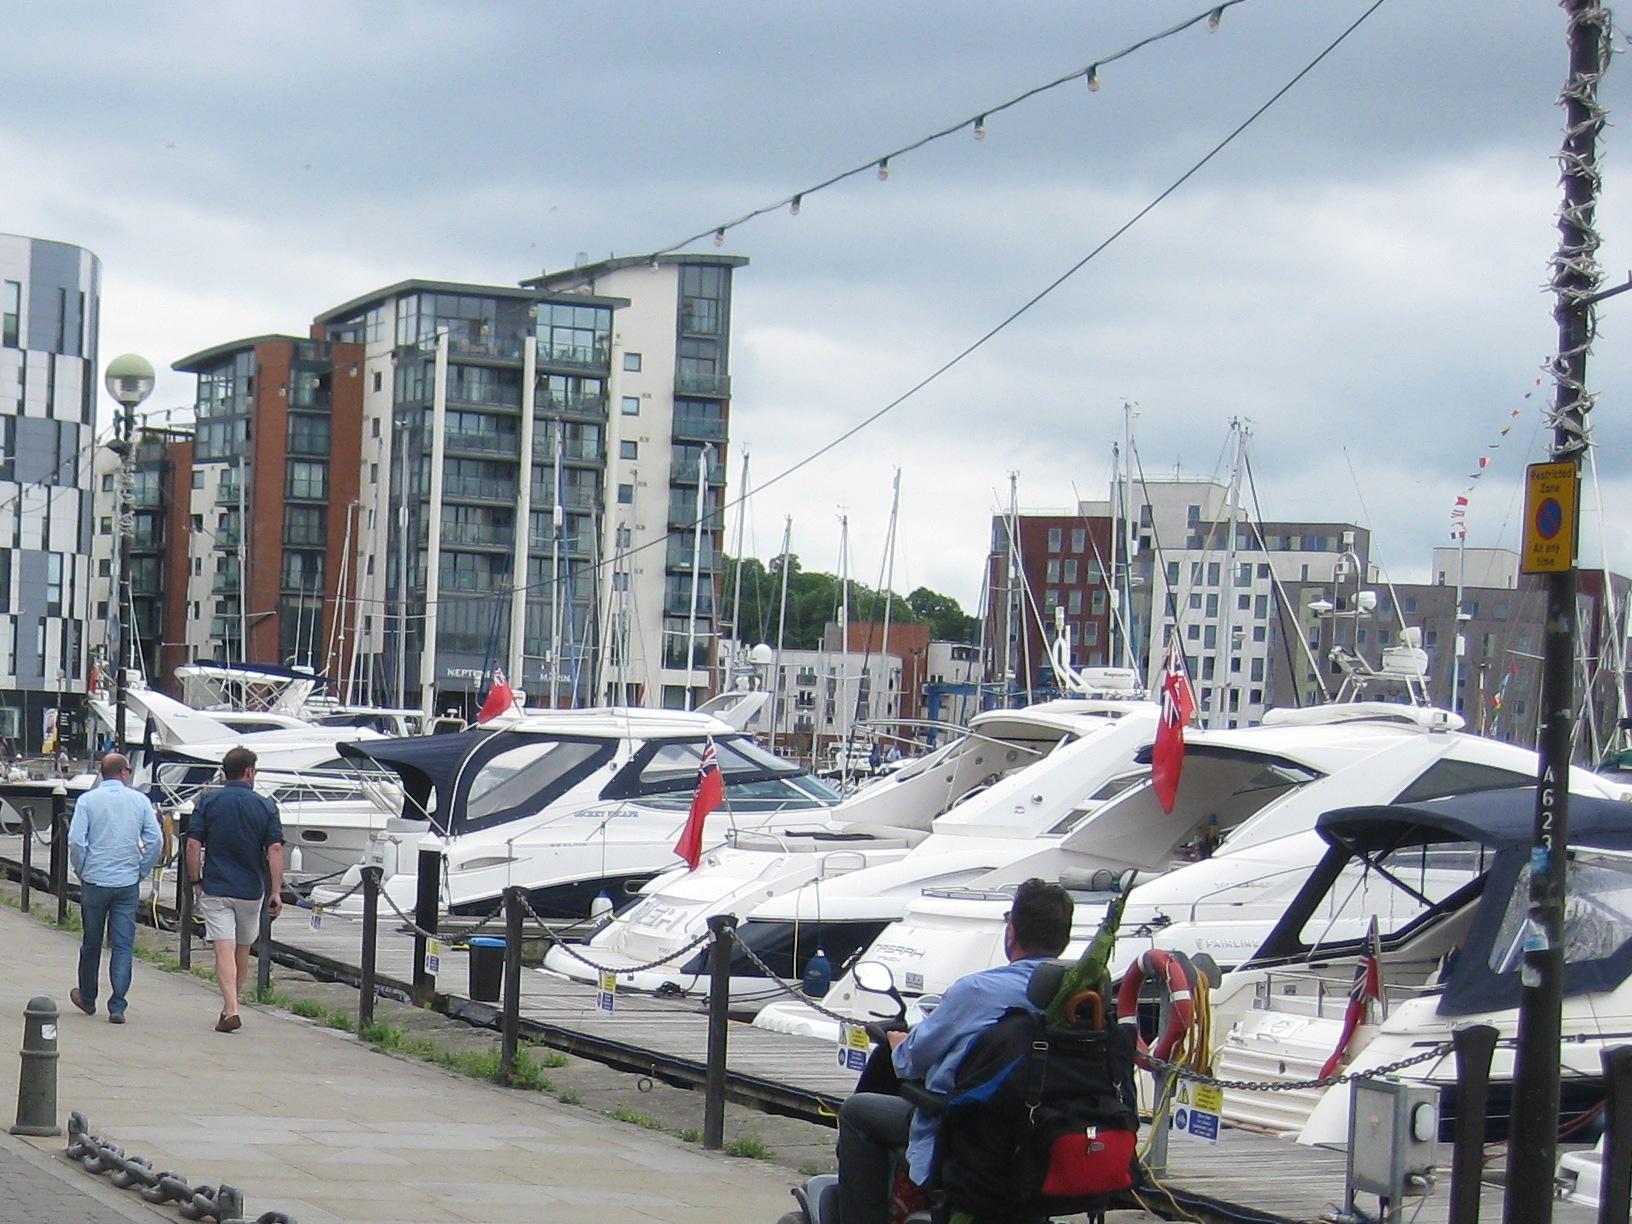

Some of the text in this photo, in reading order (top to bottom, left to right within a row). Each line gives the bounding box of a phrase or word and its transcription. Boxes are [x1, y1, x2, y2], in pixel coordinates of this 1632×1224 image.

[1530, 469, 1572, 481] Restricted
[1540, 483, 1561, 494] Zone
[1545, 544, 1561, 554] any
